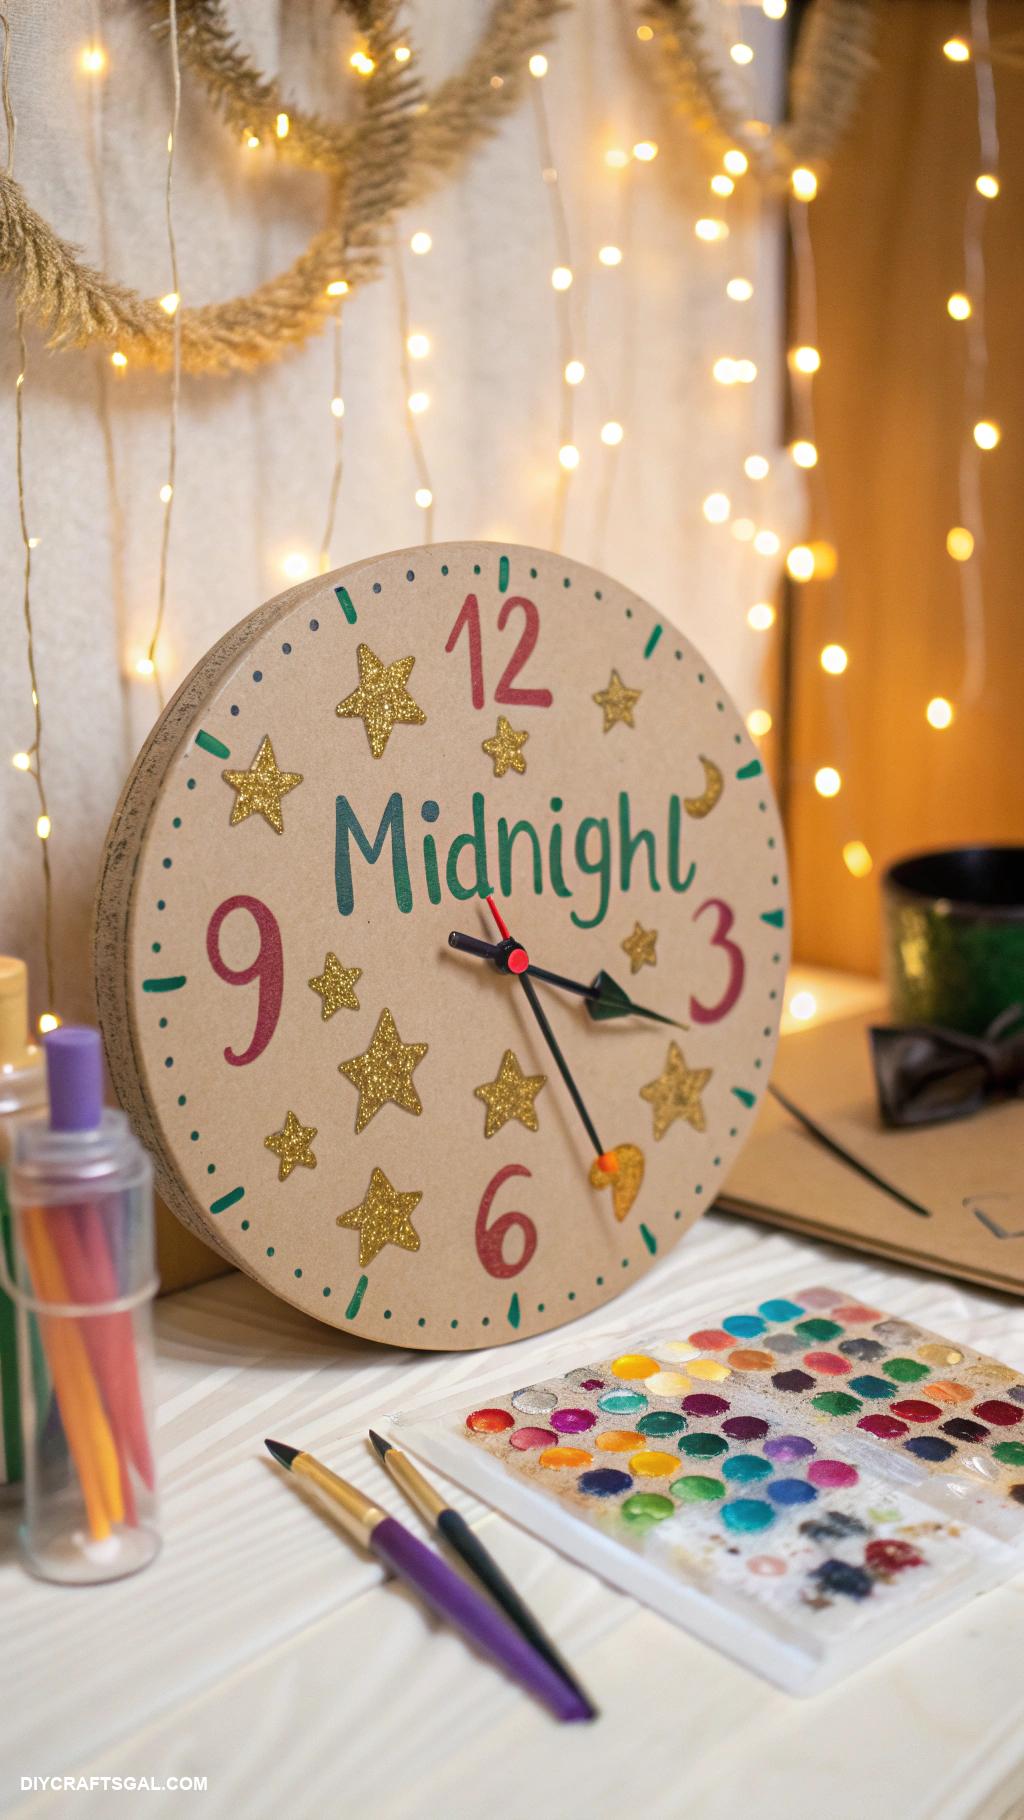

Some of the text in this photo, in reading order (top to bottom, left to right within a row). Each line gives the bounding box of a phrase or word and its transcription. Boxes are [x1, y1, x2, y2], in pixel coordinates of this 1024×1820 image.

[445, 593, 554, 710] 12
[205, 894, 284, 1067] 9
[690, 898, 745, 1026] 3
[475, 1163, 538, 1279] 6
